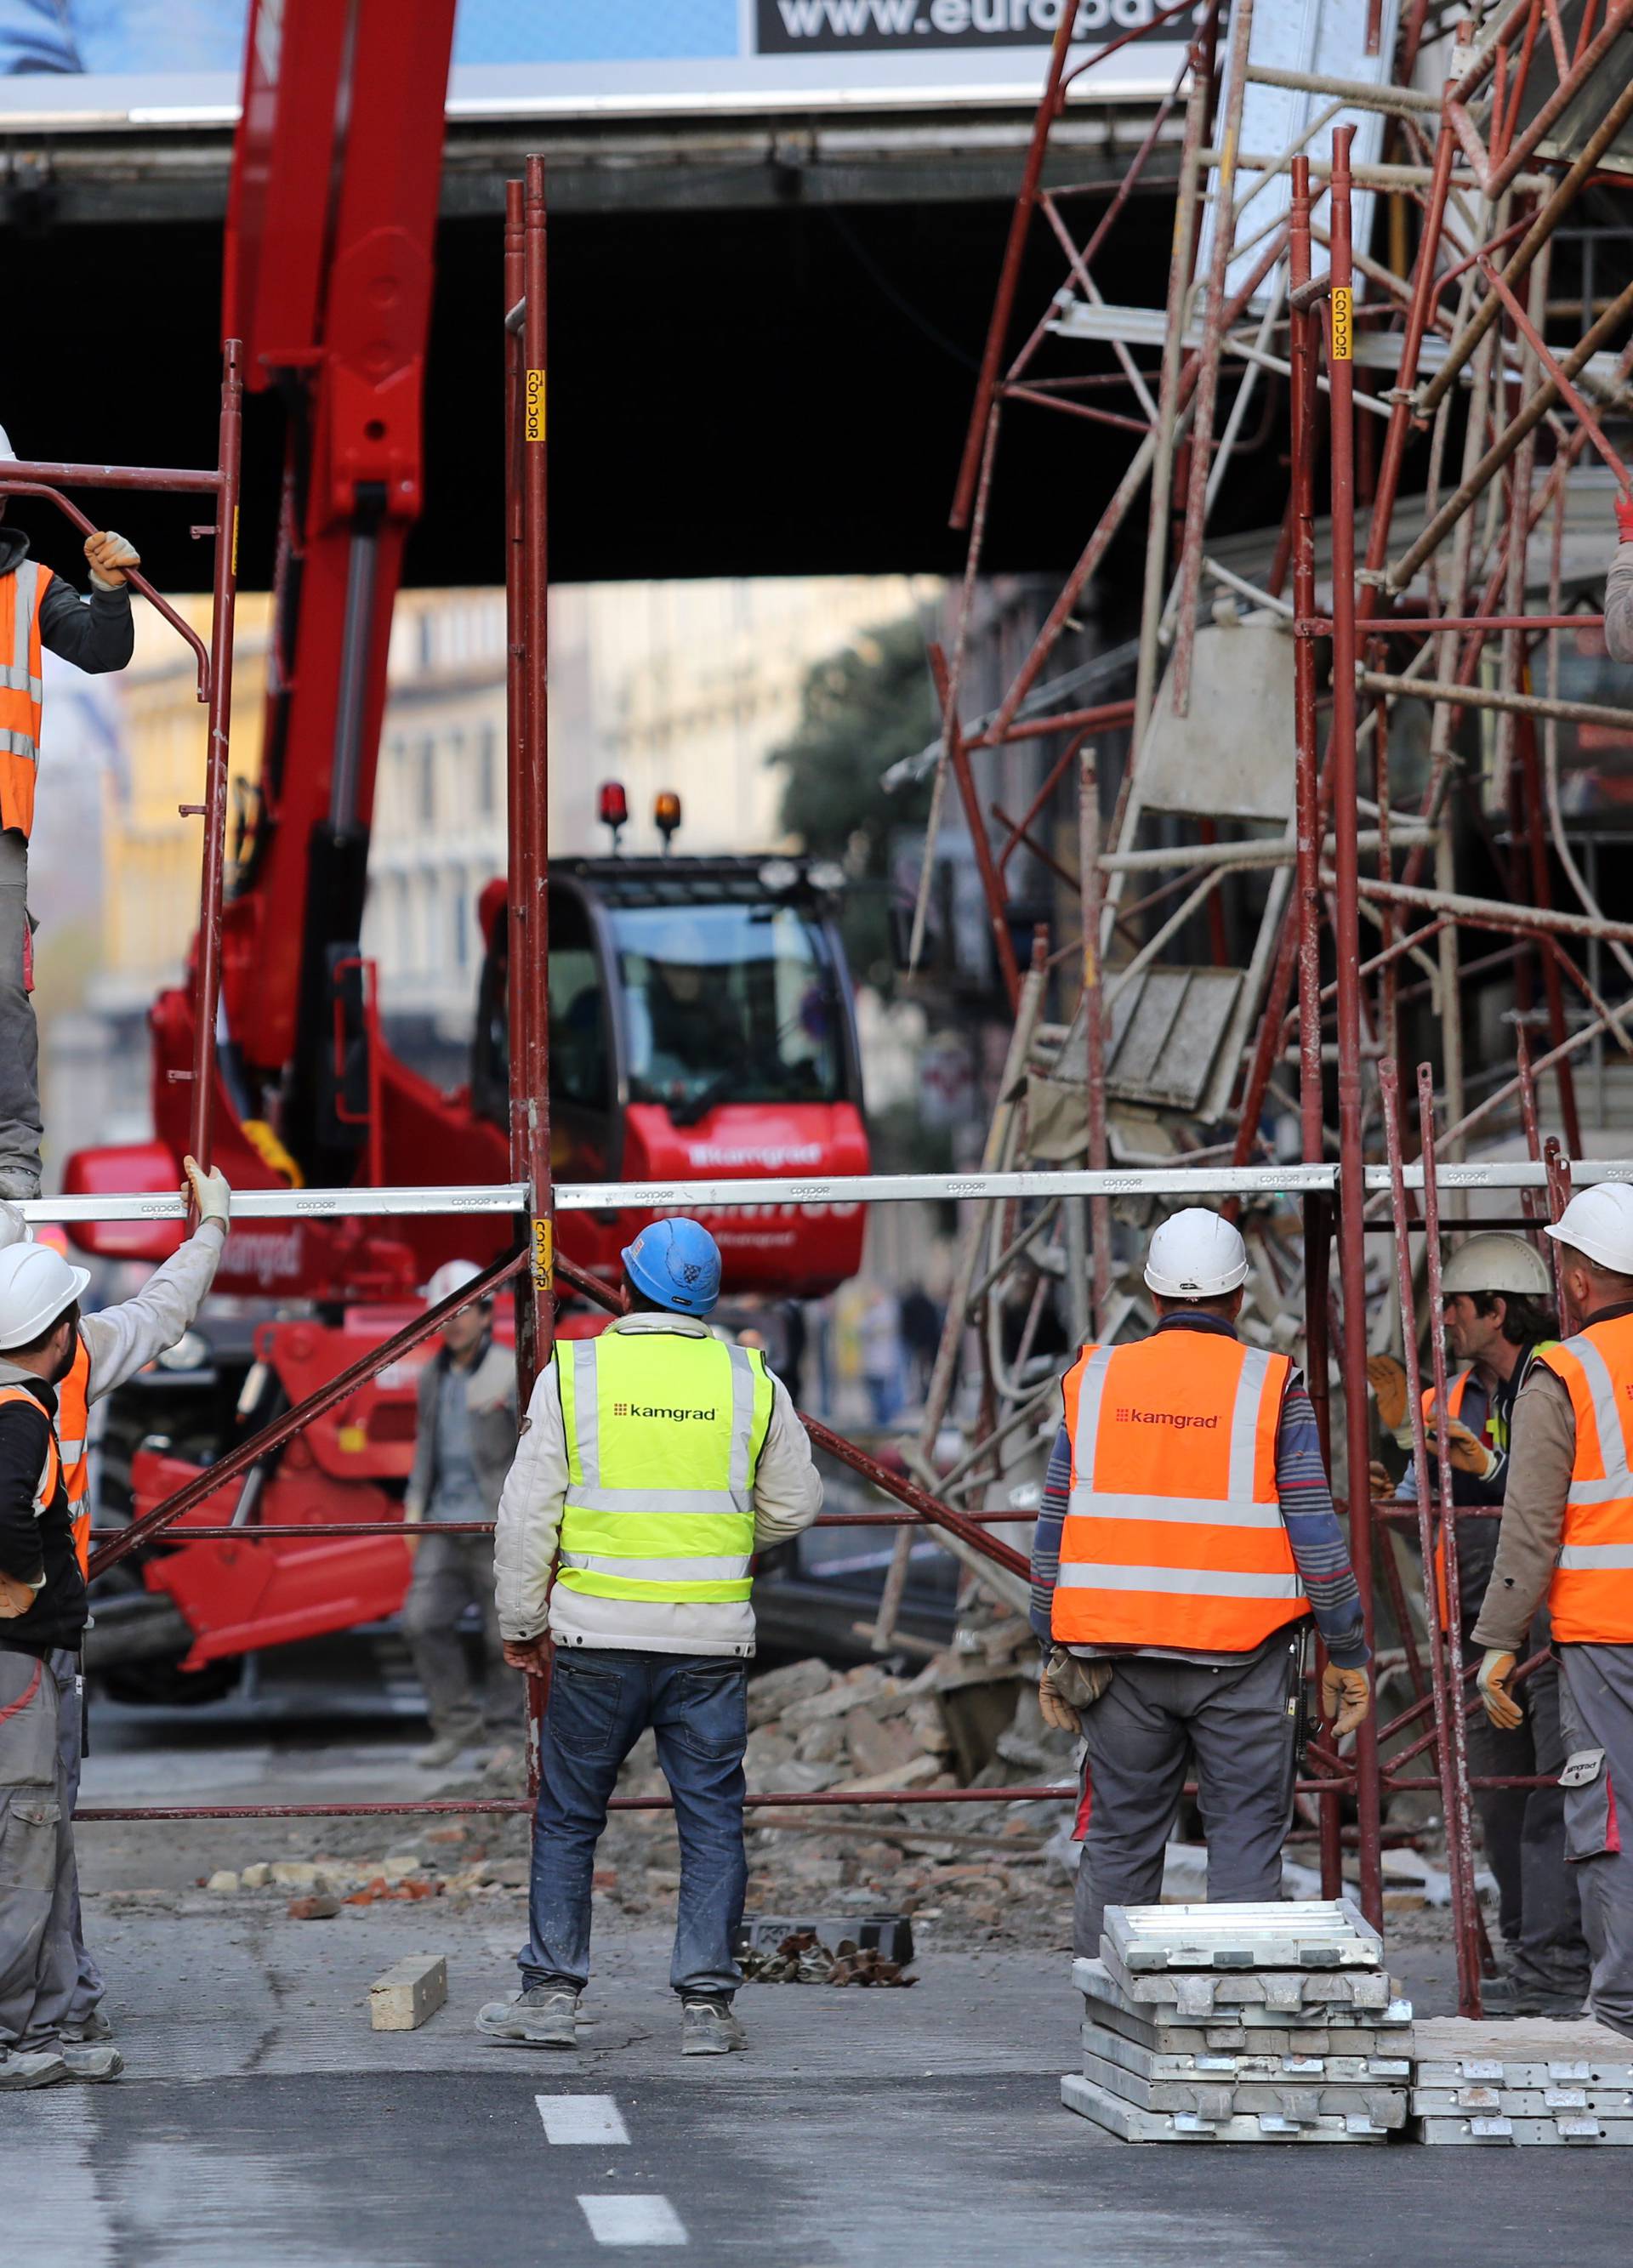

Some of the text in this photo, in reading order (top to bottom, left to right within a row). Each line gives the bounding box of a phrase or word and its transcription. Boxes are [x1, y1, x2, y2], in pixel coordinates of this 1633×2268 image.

[527, 372, 539, 439] CONDOR
[630, 1404, 715, 1422] kamgrad
[1130, 1408, 1217, 1429] kamgrad
